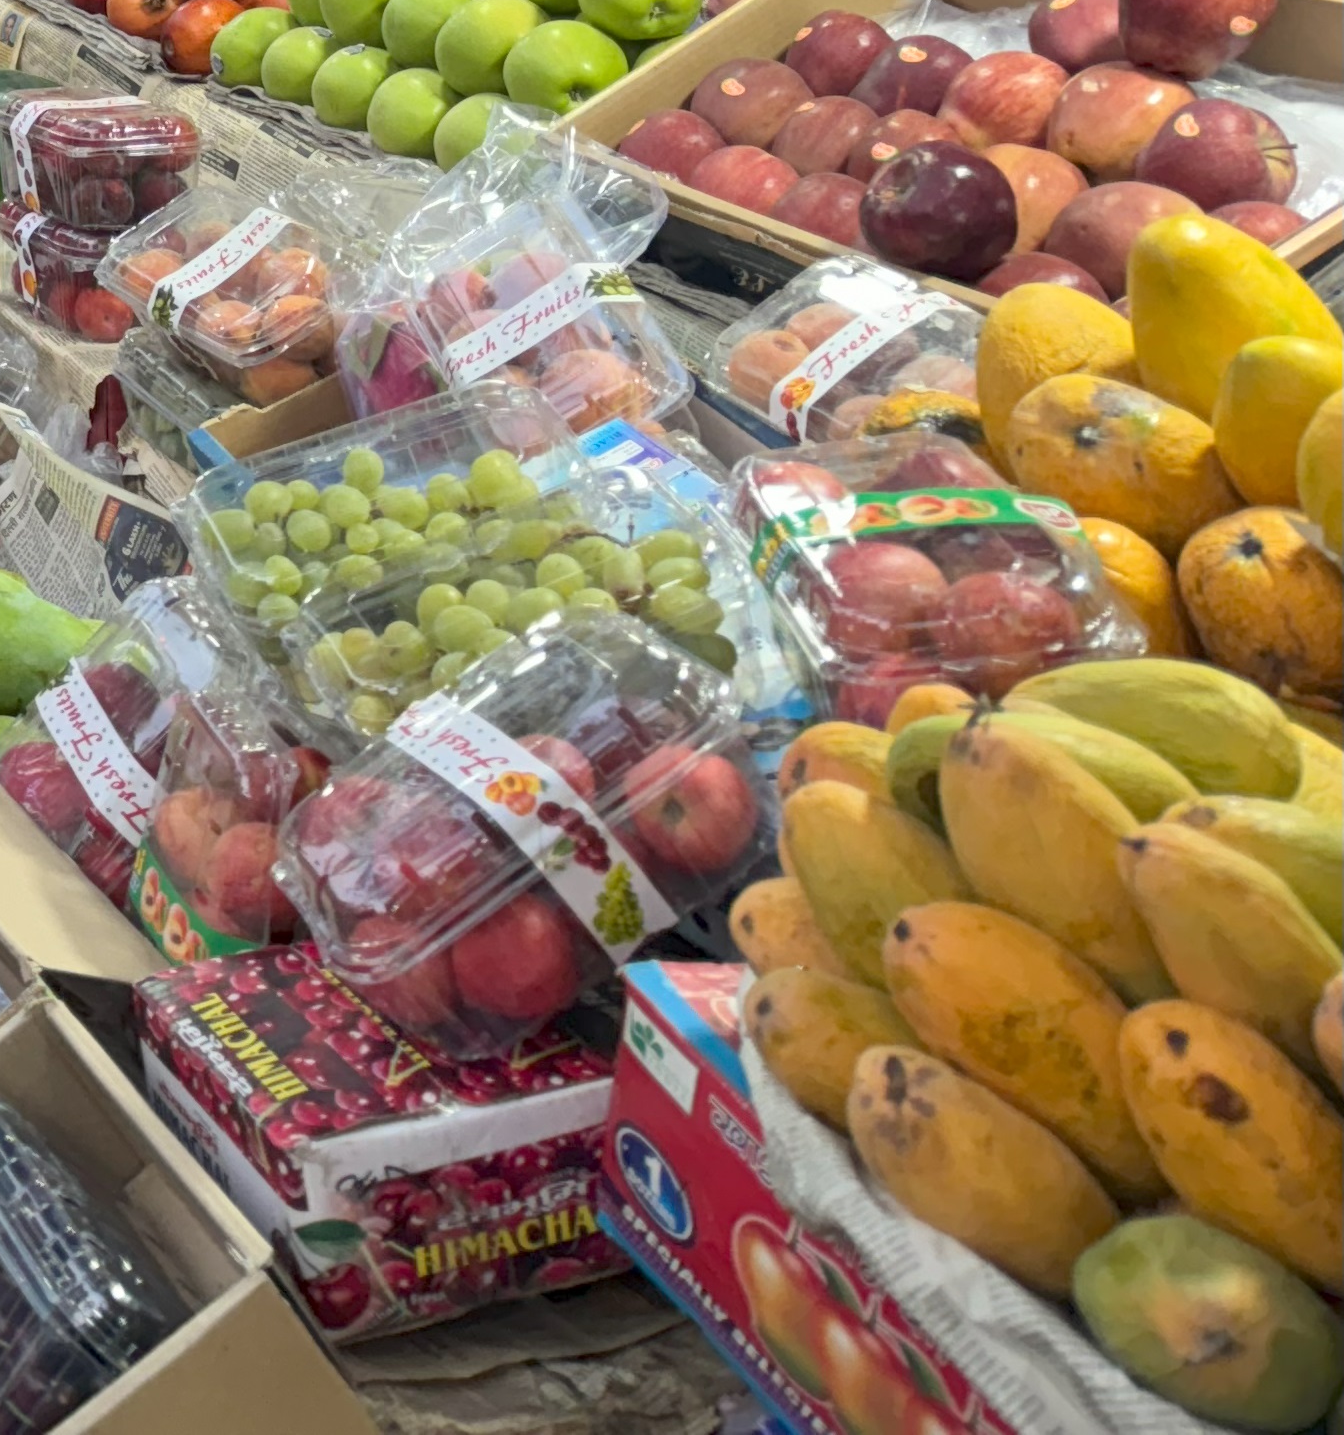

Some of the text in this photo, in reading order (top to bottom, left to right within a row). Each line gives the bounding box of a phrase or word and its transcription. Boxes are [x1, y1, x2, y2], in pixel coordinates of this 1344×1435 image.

[174, 247, 243, 293] Fruits
[504, 284, 583, 345] Fruits
[807, 319, 883, 383] Fresh
[50, 681, 152, 836] Fresh Fruits
[442, 725, 497, 787] Fresh
[191, 992, 309, 1101] HIMACHAL
[412, 1205, 598, 1278] HIMACHA
[621, 1204, 729, 1323] SPECIALLY
[730, 1327, 836, 1435] SELECTE
